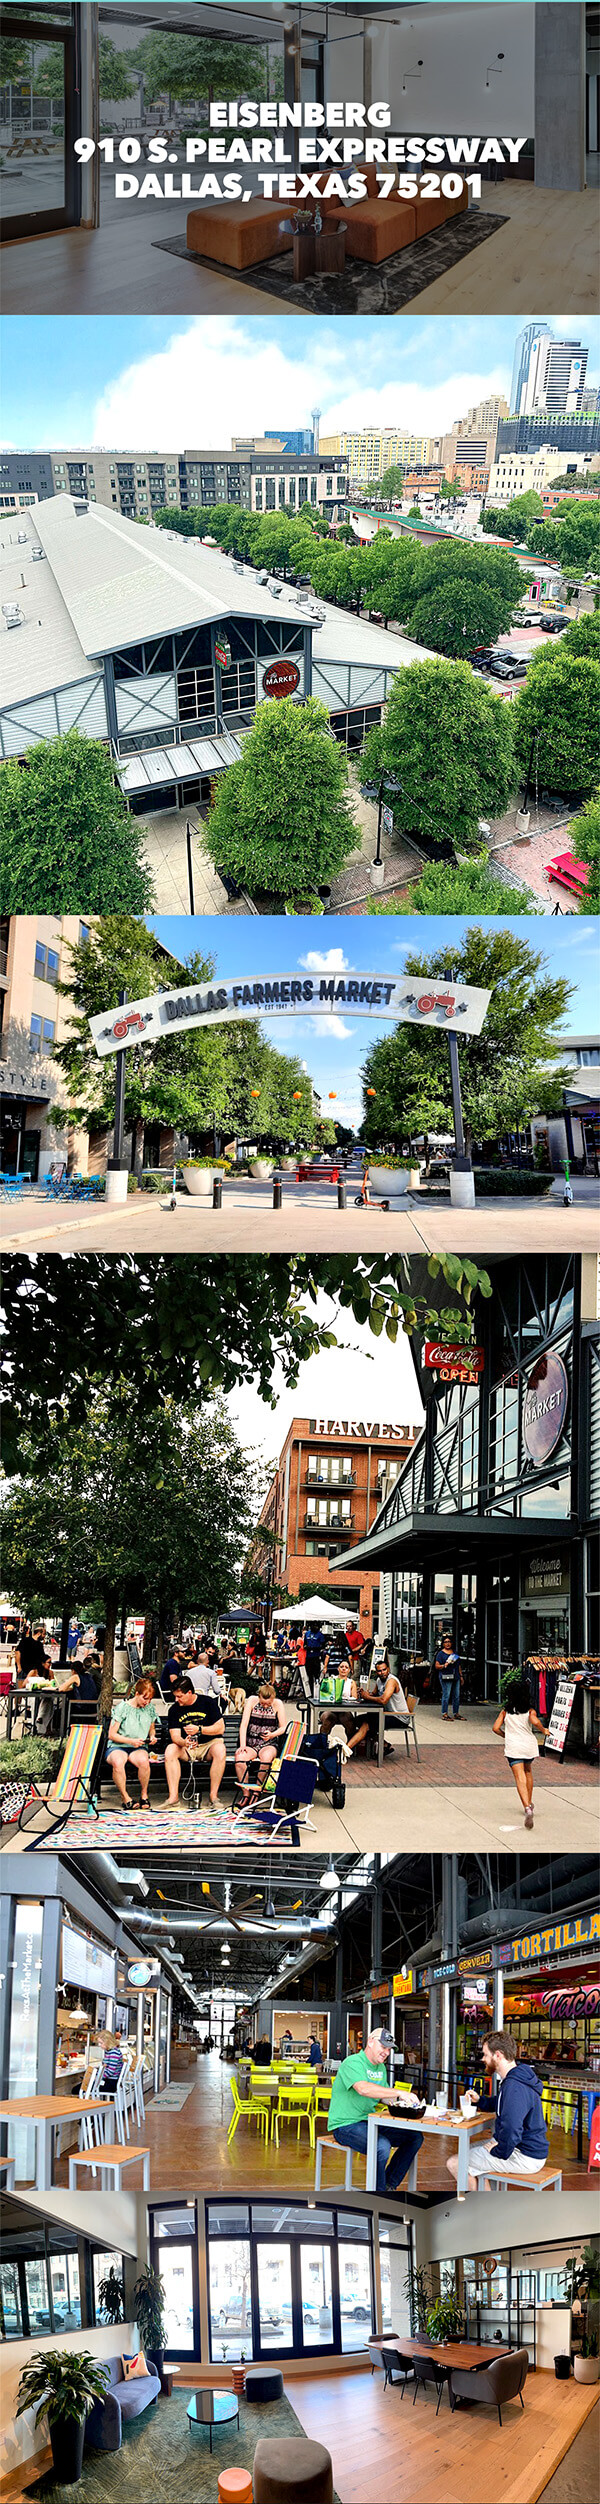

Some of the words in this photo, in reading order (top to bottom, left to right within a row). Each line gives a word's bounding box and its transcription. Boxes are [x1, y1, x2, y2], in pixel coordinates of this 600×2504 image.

[266, 674, 298, 685] MARKET
[164, 988, 228, 1021] DALLAS
[232, 979, 314, 1006] FARMERS
[319, 980, 396, 1006] MARKET
[440, 1368, 479, 1384] OPEN
[525, 1389, 563, 1428] MARKET
[314, 1418, 422, 1440] HARVEST
[459, 1953, 491, 1971] CERVEZA
